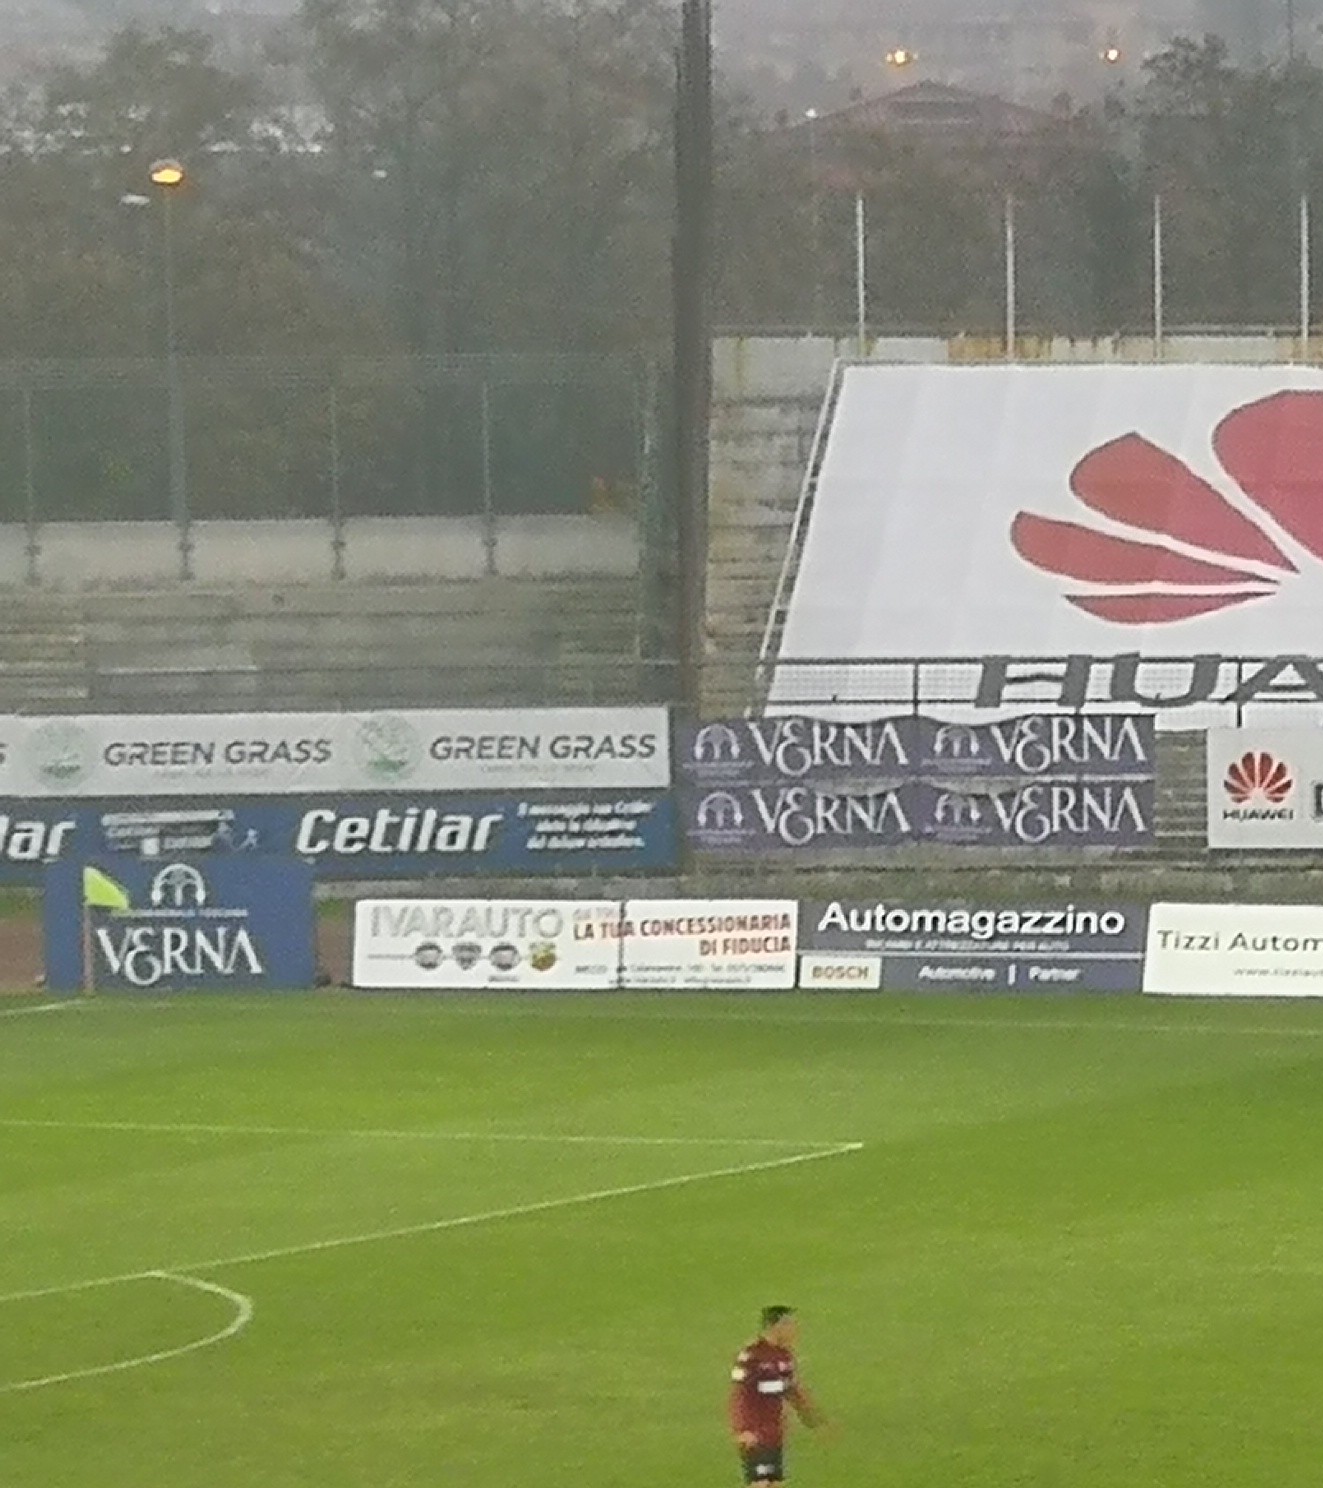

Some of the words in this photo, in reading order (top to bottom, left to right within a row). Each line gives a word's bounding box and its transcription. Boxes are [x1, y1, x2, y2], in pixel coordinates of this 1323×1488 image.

[104, 741, 216, 766] GREEN
[224, 739, 333, 764] GRASS
[430, 736, 540, 760] GREEN
[550, 734, 656, 759] GRASS
[748, 720, 908, 776] VERNA
[990, 716, 1147, 773] VERNA
[296, 807, 503, 854] Cetilar
[752, 787, 911, 846] VERNA
[988, 785, 1147, 843] VERNA
[1223, 809, 1293, 822] HUAWEI
[370, 905, 563, 938] IVARAUTO
[574, 923, 594, 940] LA
[601, 920, 635, 939] TUA
[640, 913, 791, 937] CONCESSIONARIA
[817, 901, 1125, 939] Automagazzino
[97, 926, 263, 986] VERNA
[700, 938, 717, 956] DI
[723, 936, 791, 955] FIDUCIA
[1158, 930, 1219, 951] Tizzi
[812, 966, 868, 979] BOSCH
